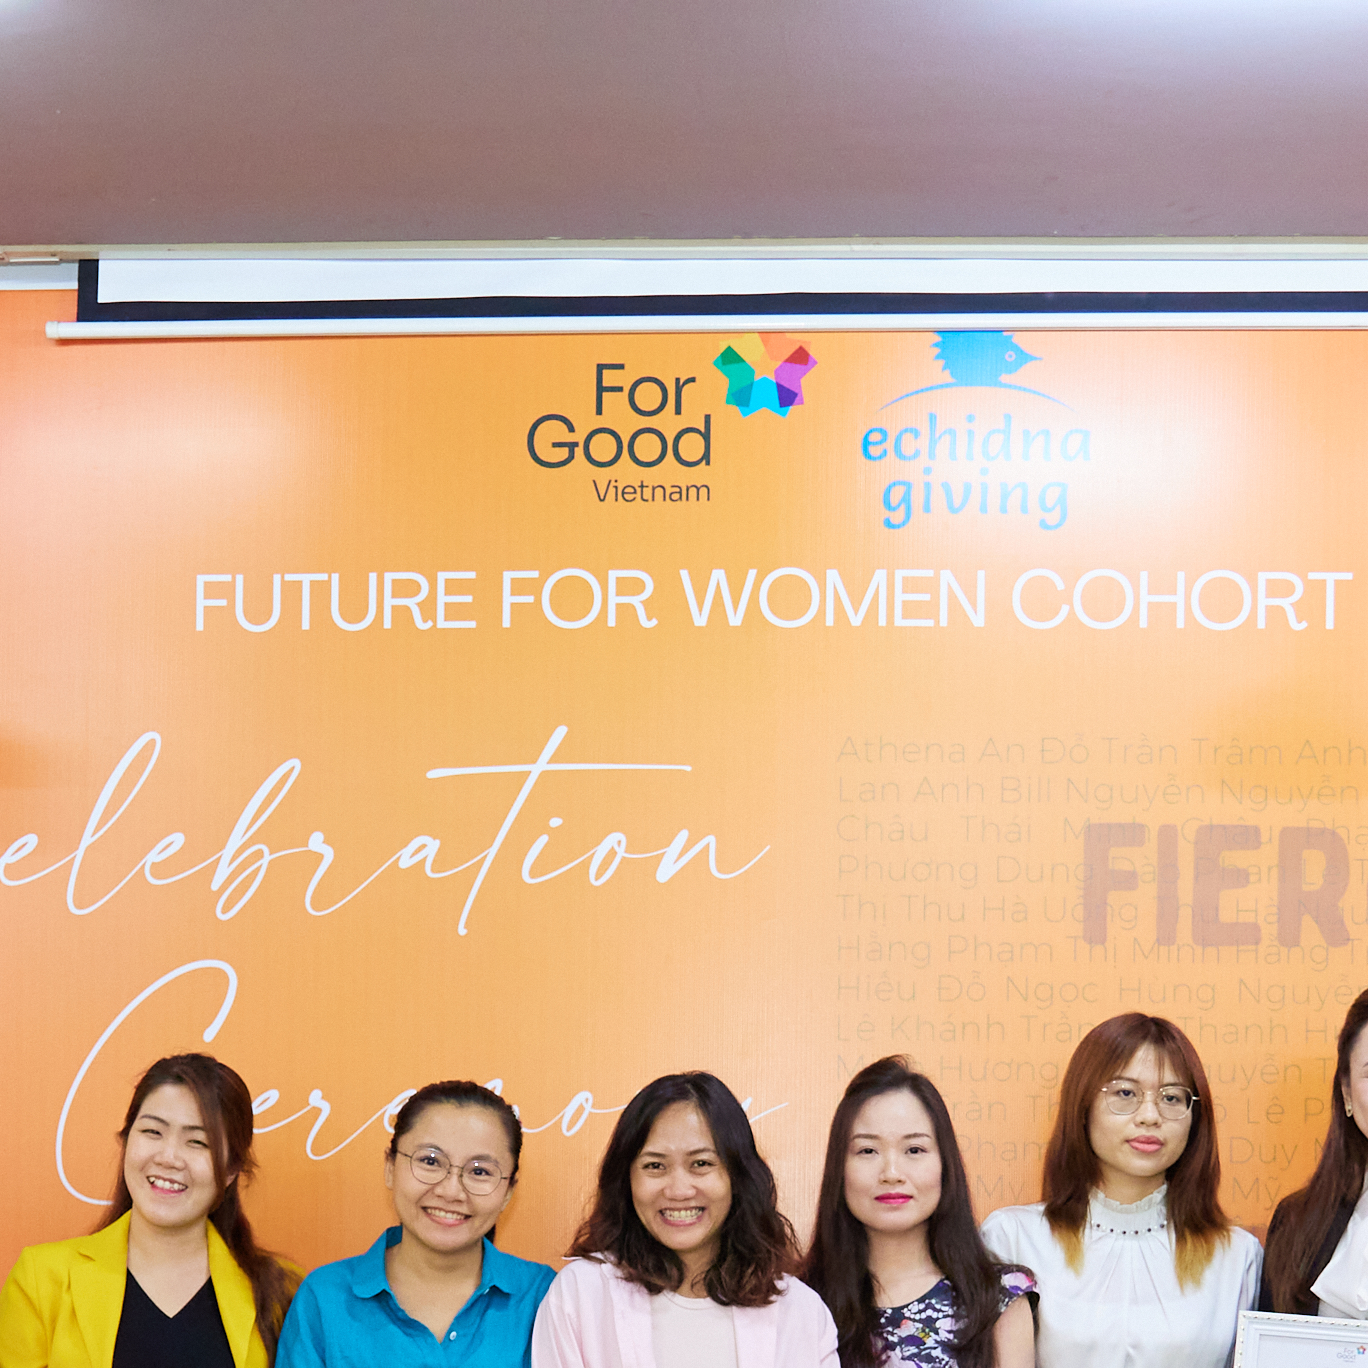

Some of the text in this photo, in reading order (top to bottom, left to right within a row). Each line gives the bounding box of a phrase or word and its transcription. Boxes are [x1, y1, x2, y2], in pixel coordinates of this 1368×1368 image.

[595, 363, 696, 417] For
[527, 414, 712, 468] Good
[861, 412, 1092, 463] echidna
[592, 478, 711, 503] Vietnam
[882, 466, 1069, 531] giving
[195, 572, 477, 633] FUTURE
[502, 567, 658, 630] FOR
[679, 566, 986, 629] WOMEN
[1012, 568, 1354, 631] COHORT
[836, 735, 967, 764] Athena
[978, 736, 1026, 764] An
[1294, 738, 1368, 767] Anh
[838, 776, 900, 803] Lan
[913, 775, 985, 803] Anh
[1000, 775, 1052, 803] Bill
[996, 855, 1094, 890] Dung
[900, 894, 965, 922] Thu
[982, 893, 1029, 923] Hà
[1132, 936, 1221, 964] Minh
[837, 1013, 876, 1043] Lê
[1247, 1093, 1286, 1124] Lê
[1230, 1137, 1299, 1174] Duy
